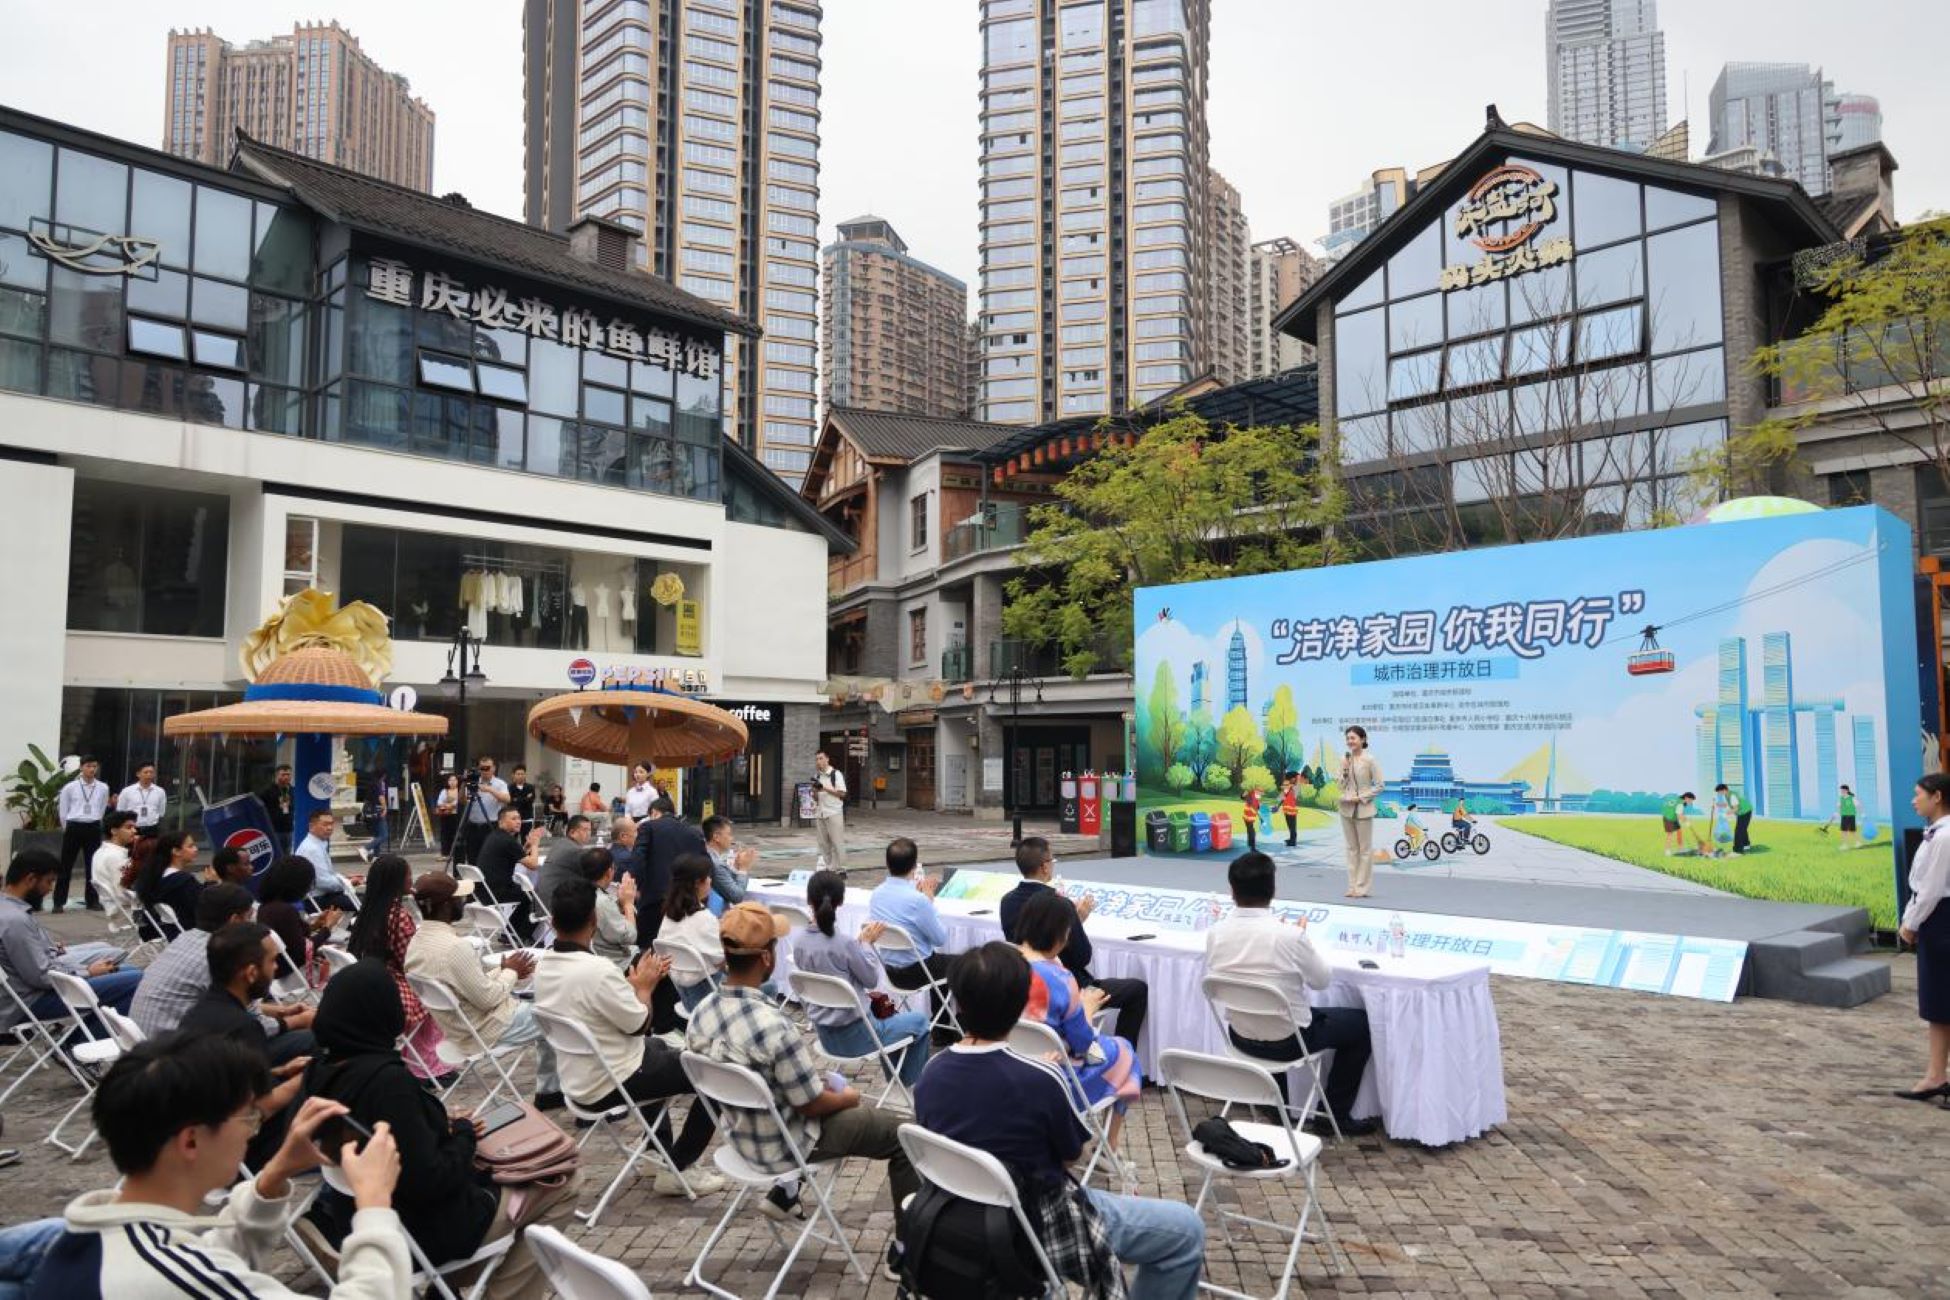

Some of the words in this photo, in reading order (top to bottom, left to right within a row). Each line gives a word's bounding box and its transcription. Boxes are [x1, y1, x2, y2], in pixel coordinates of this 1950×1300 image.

[365, 257, 719, 379] 重庆必来的鱼鲜馆
[1272, 609, 1437, 665] “洁净家园
[1441, 589, 1645, 659] 你我同行”
[1374, 659, 1492, 681] 城市治理开放日
